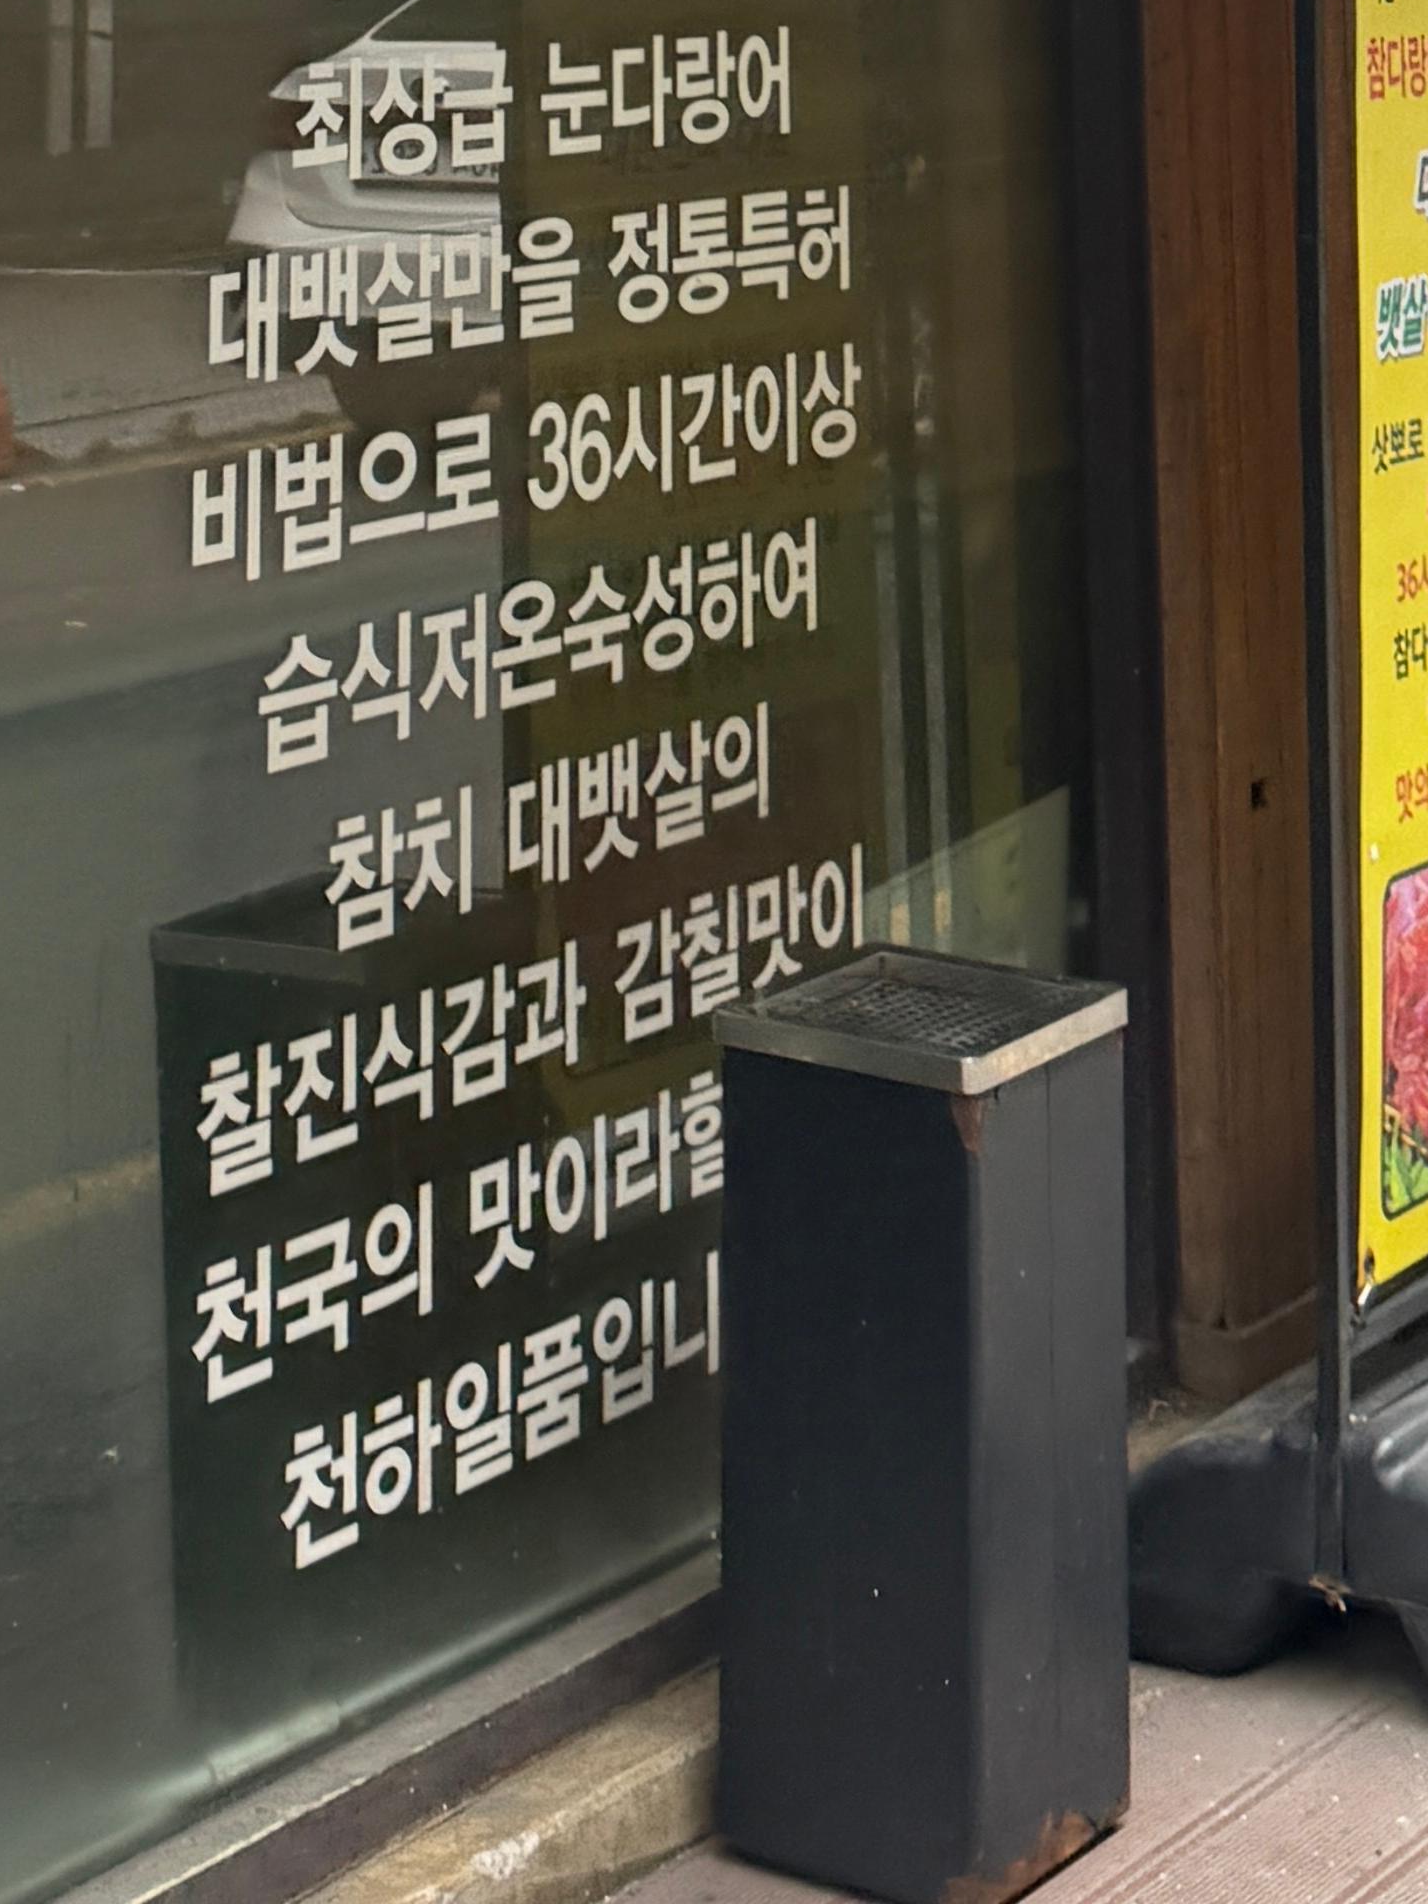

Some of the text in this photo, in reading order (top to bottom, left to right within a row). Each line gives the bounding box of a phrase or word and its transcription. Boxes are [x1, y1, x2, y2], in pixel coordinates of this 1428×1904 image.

[291, 25, 791, 179] 최상급 눈다랑어
[208, 185, 851, 383] 대뱃살만을 정통특허
[191, 343, 862, 581] 비법으로 36시간이상
[258, 516, 818, 775] 습식저온숙성하여
[325, 702, 769, 952] 참치 대뱃살의
[196, 843, 863, 1196] 찰진식감과 감칠맛이
[192, 1183, 433, 1404] 천국의
